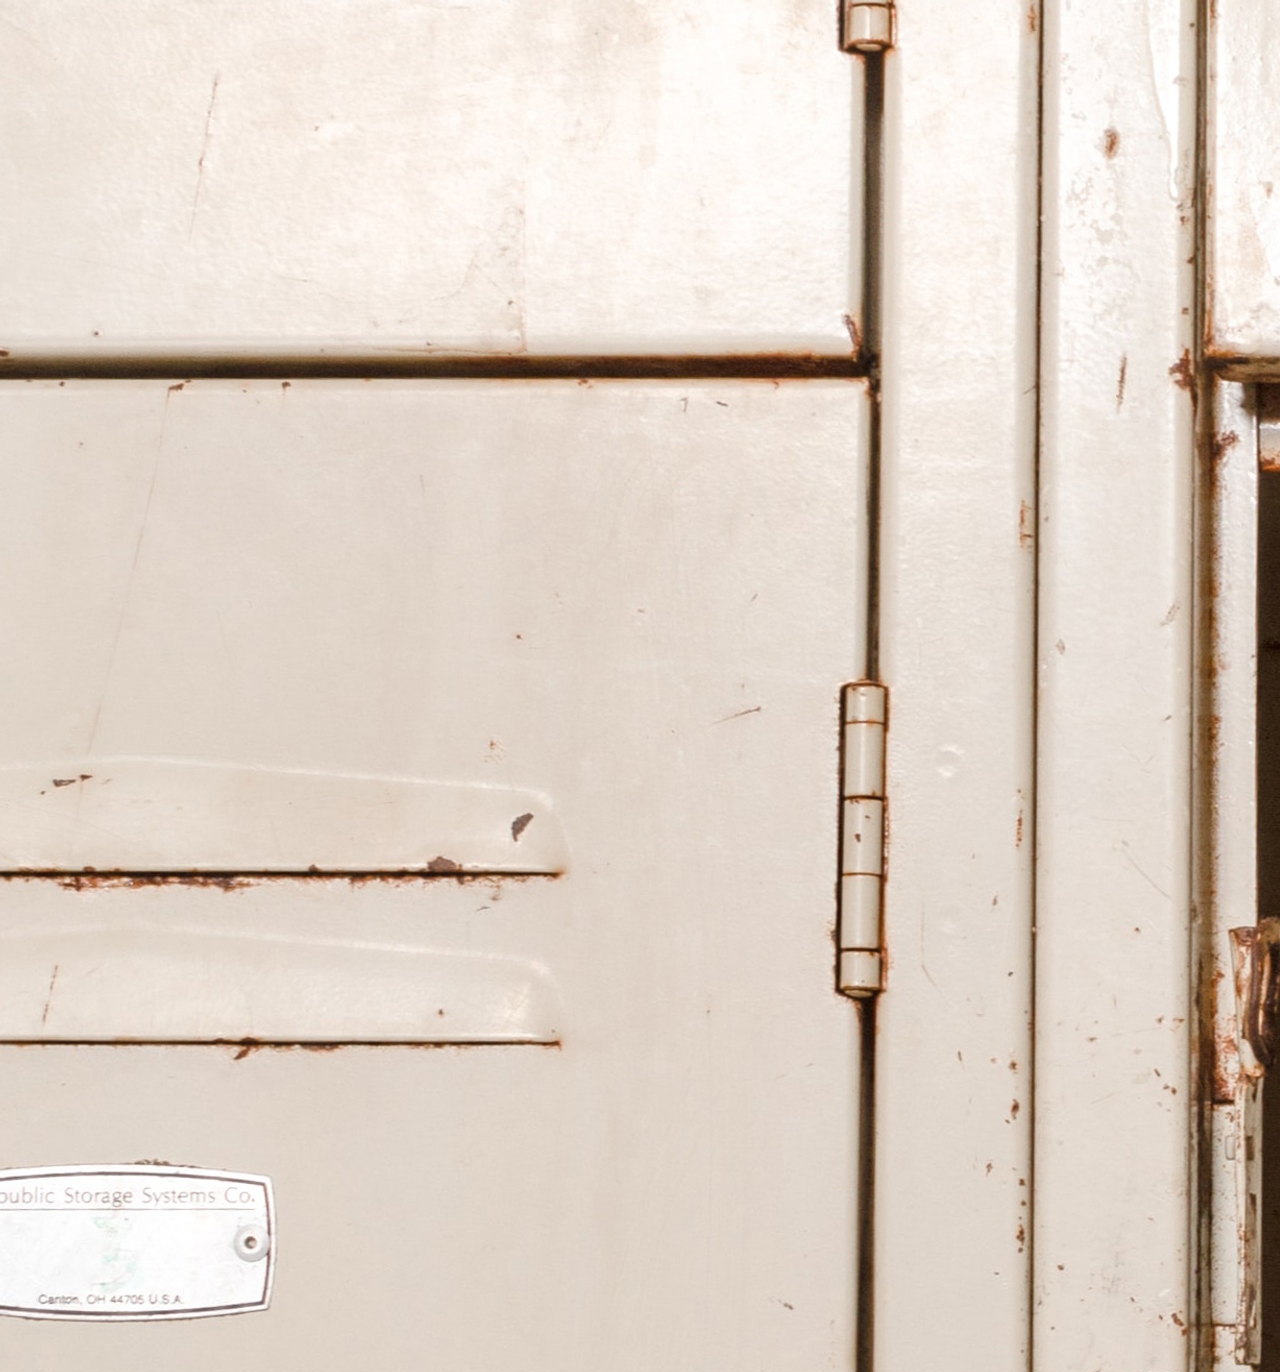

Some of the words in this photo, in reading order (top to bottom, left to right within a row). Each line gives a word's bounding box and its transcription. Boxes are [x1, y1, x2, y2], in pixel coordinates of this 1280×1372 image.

[64, 1186, 133, 1208] Storage
[142, 1187, 216, 1206] Systems
[224, 1187, 256, 1204] Co.
[38, 1294, 83, 1305] Canton,
[86, 1294, 106, 1304] OH
[110, 1295, 144, 1305] 44705
